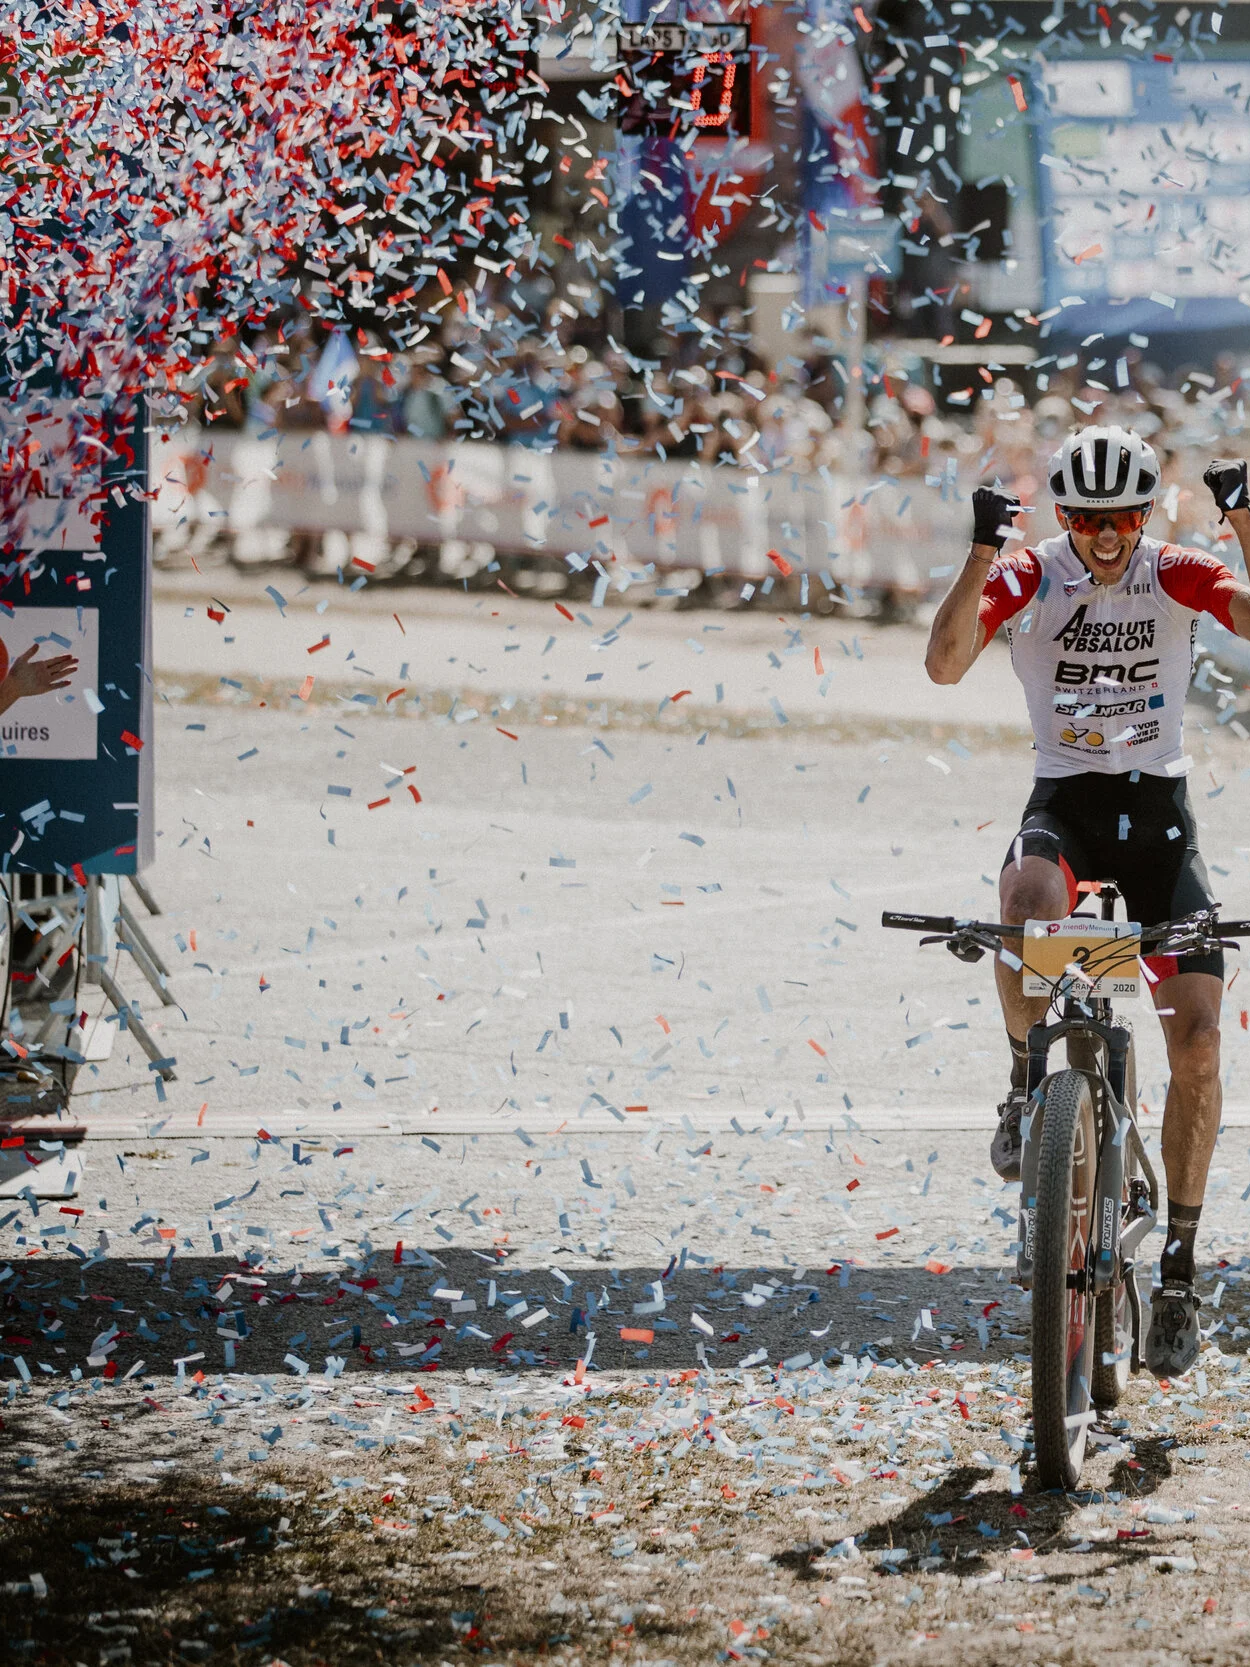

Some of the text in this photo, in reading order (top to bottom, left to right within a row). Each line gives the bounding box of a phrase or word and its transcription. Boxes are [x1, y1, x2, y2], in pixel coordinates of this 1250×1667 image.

[1053, 604, 1155, 641] ABSOLUTE
[1055, 658, 1159, 685] BMC
[1055, 685, 1146, 696] SWITZERLAND
[2, 721, 50, 741] uires
[1113, 984, 1136, 993] 2020
